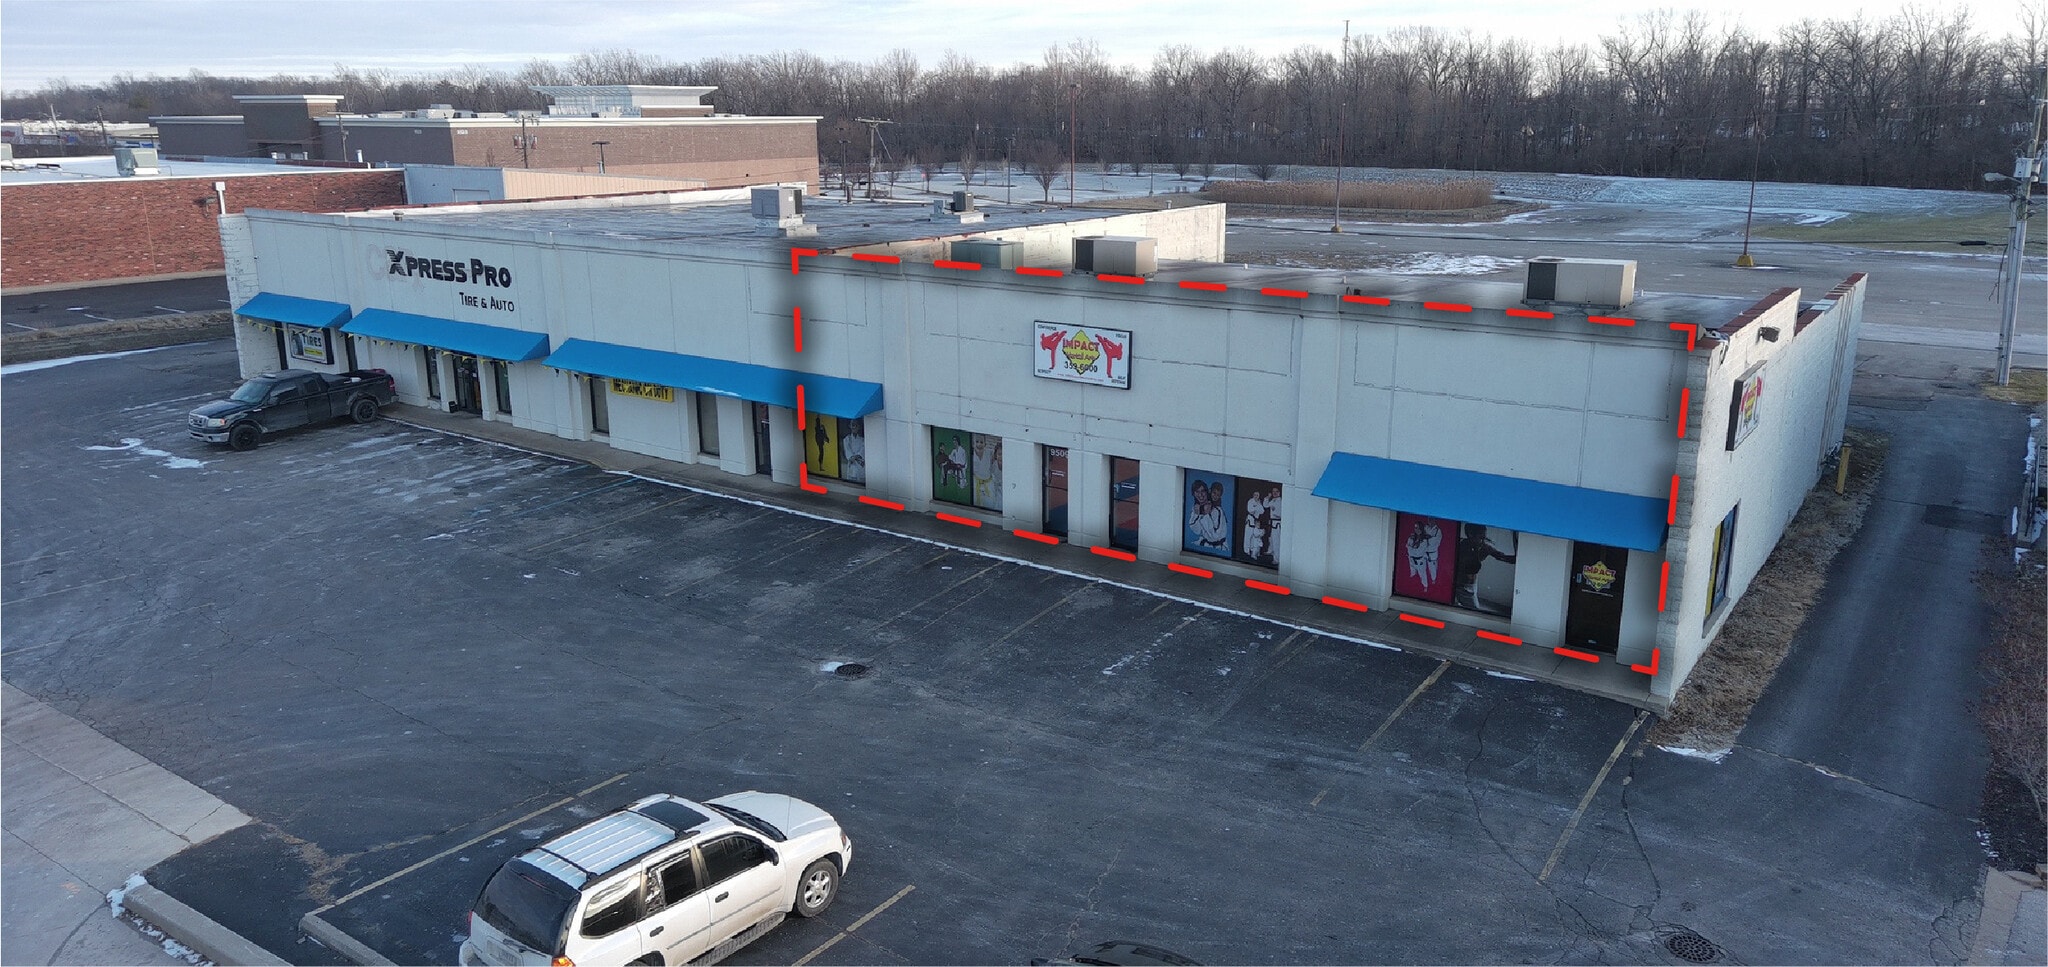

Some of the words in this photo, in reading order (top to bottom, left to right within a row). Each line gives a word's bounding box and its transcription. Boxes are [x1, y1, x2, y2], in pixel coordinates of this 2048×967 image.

[385, 249, 468, 283] XPRESS
[470, 258, 513, 288] PRO
[459, 292, 479, 308] TIRE
[481, 298, 488, 309] &
[490, 296, 515, 312] AUTO
[302, 333, 323, 347] TIRES
[1063, 338, 1100, 352] IMPACT
